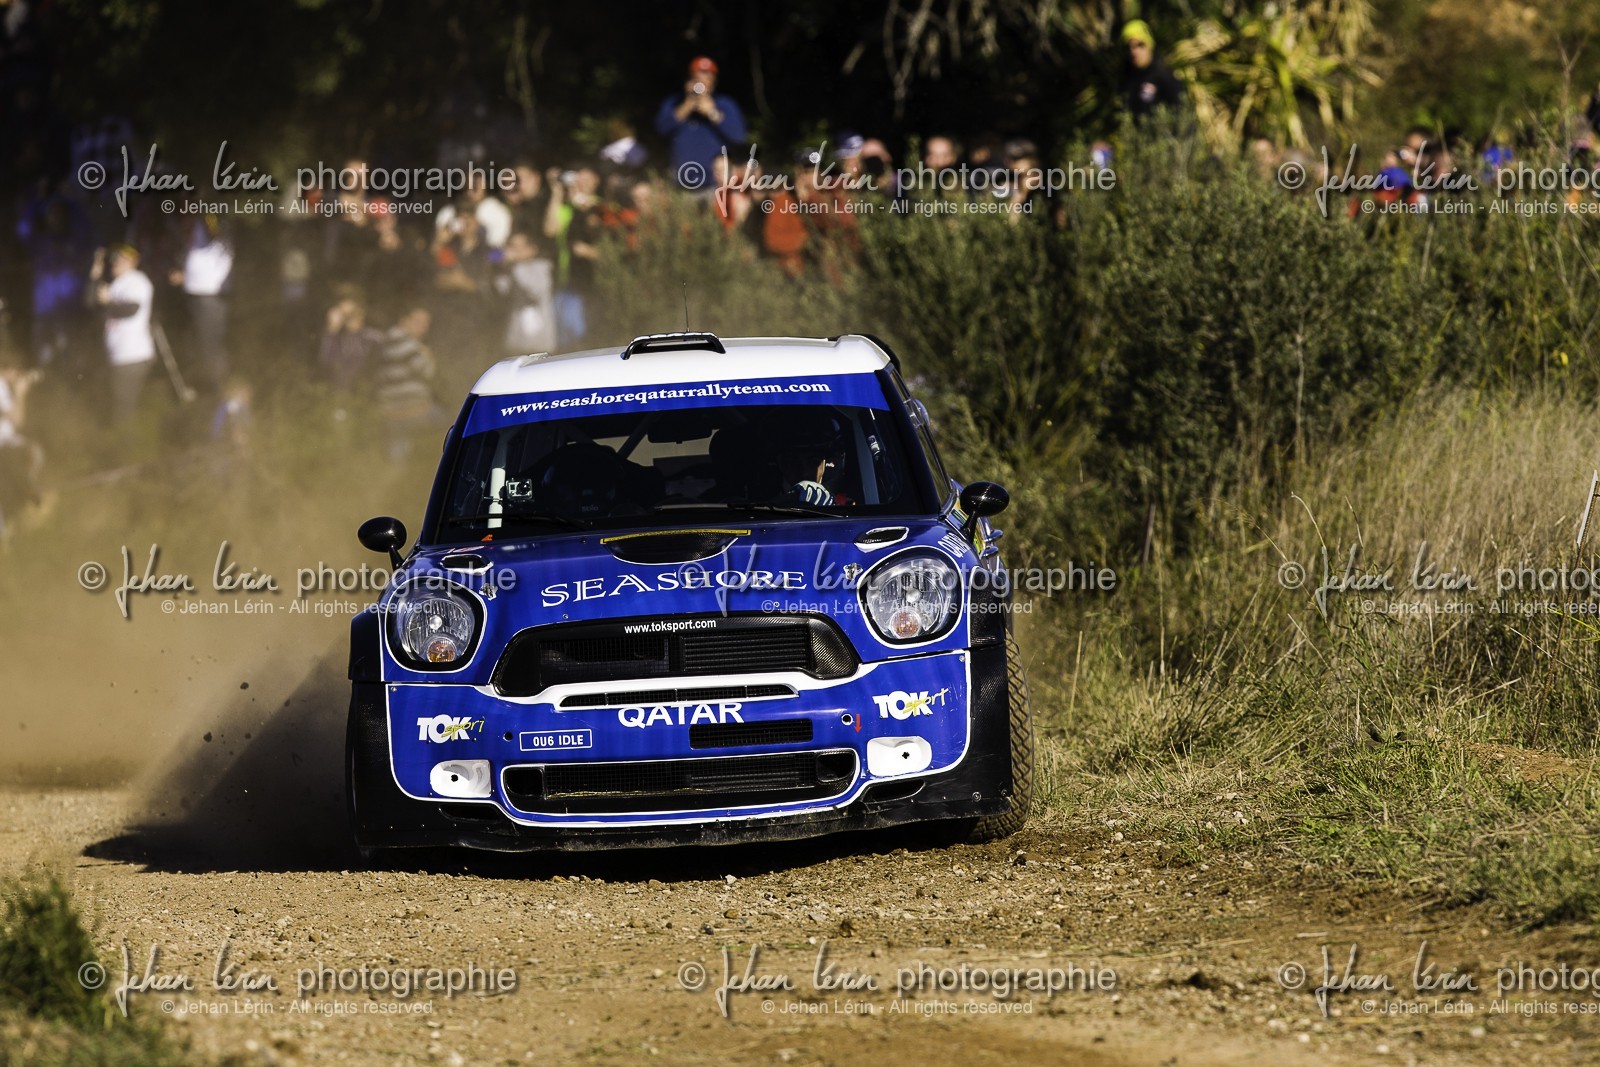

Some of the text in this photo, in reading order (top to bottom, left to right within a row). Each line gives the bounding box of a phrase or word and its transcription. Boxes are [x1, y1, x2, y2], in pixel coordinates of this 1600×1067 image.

[501, 380, 831, 417] www.seashoreqatarrallyteam.com
[541, 570, 808, 607] SEASHORE
[624, 618, 717, 635] www.toksport.com
[617, 702, 745, 729] QATAR
[873, 690, 933, 720] TOK
[416, 714, 473, 744] TOK
